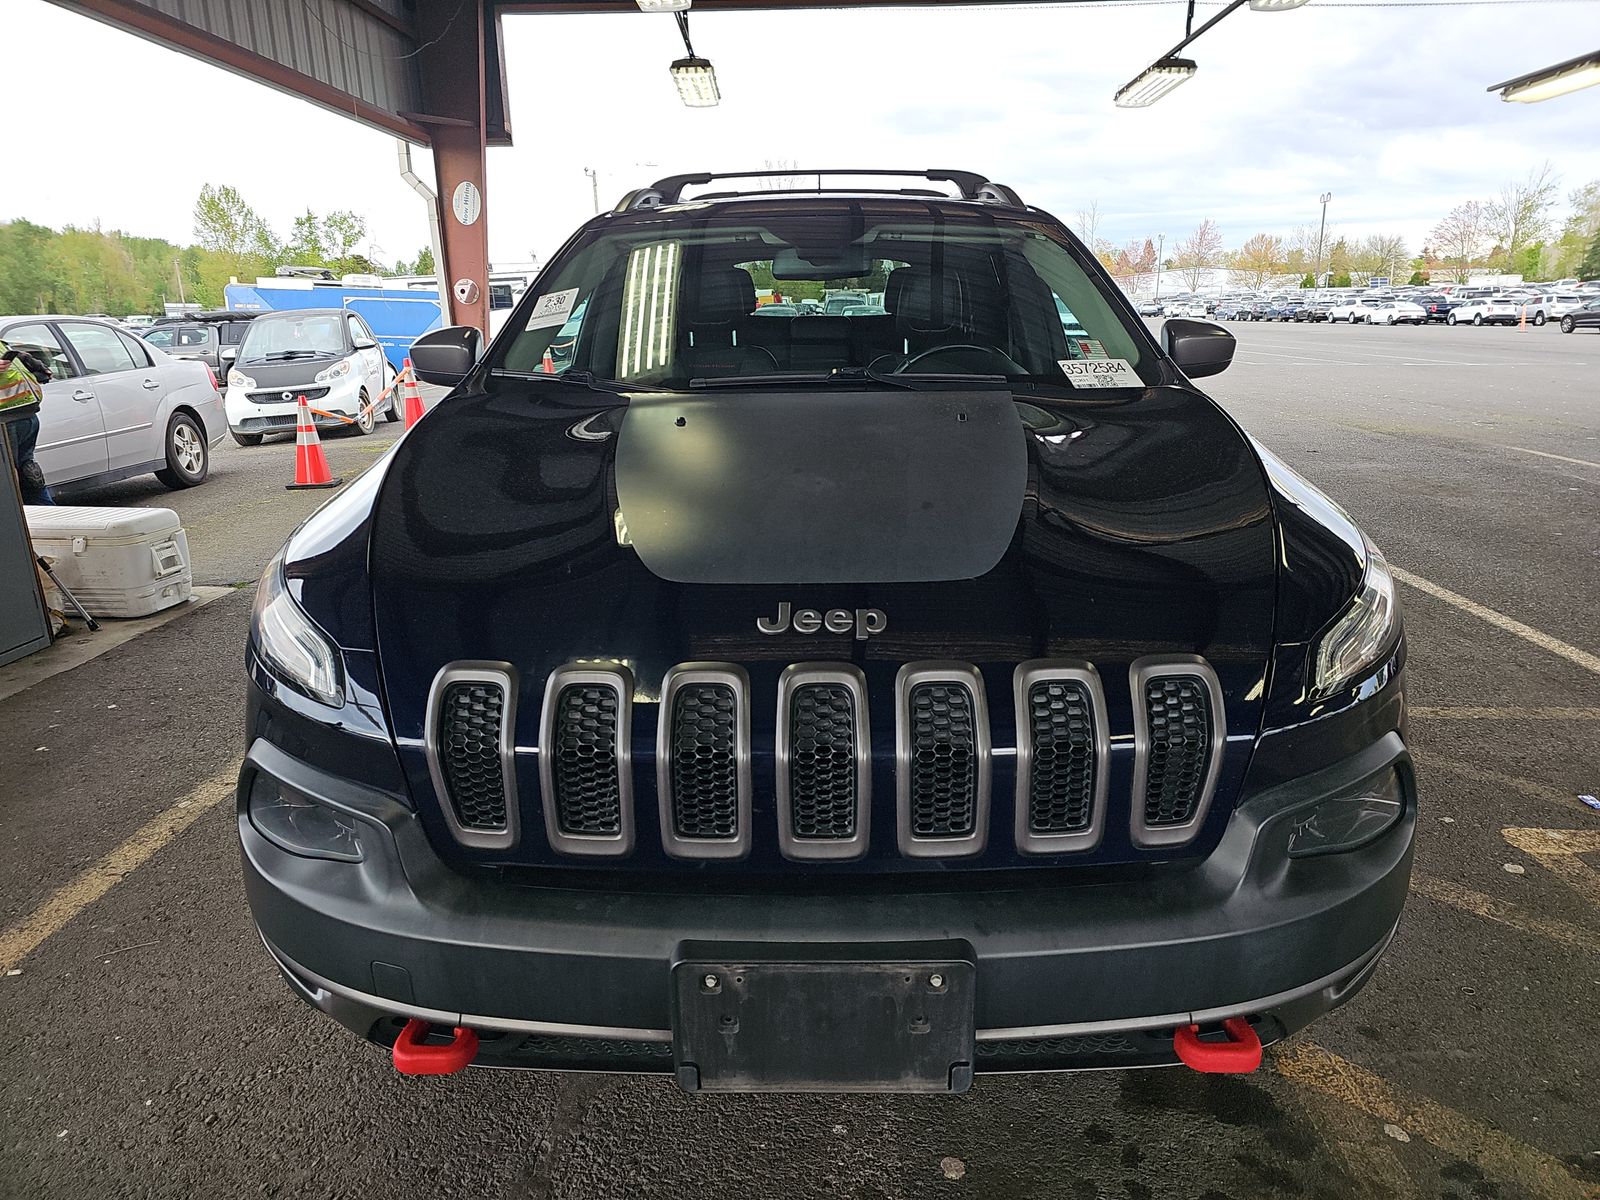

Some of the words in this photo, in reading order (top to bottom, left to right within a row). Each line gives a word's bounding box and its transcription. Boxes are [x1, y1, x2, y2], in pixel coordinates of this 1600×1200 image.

[463, 183, 472, 206] Hiring
[1062, 362, 1126, 375] 3572584
[757, 601, 887, 640] Jeep
